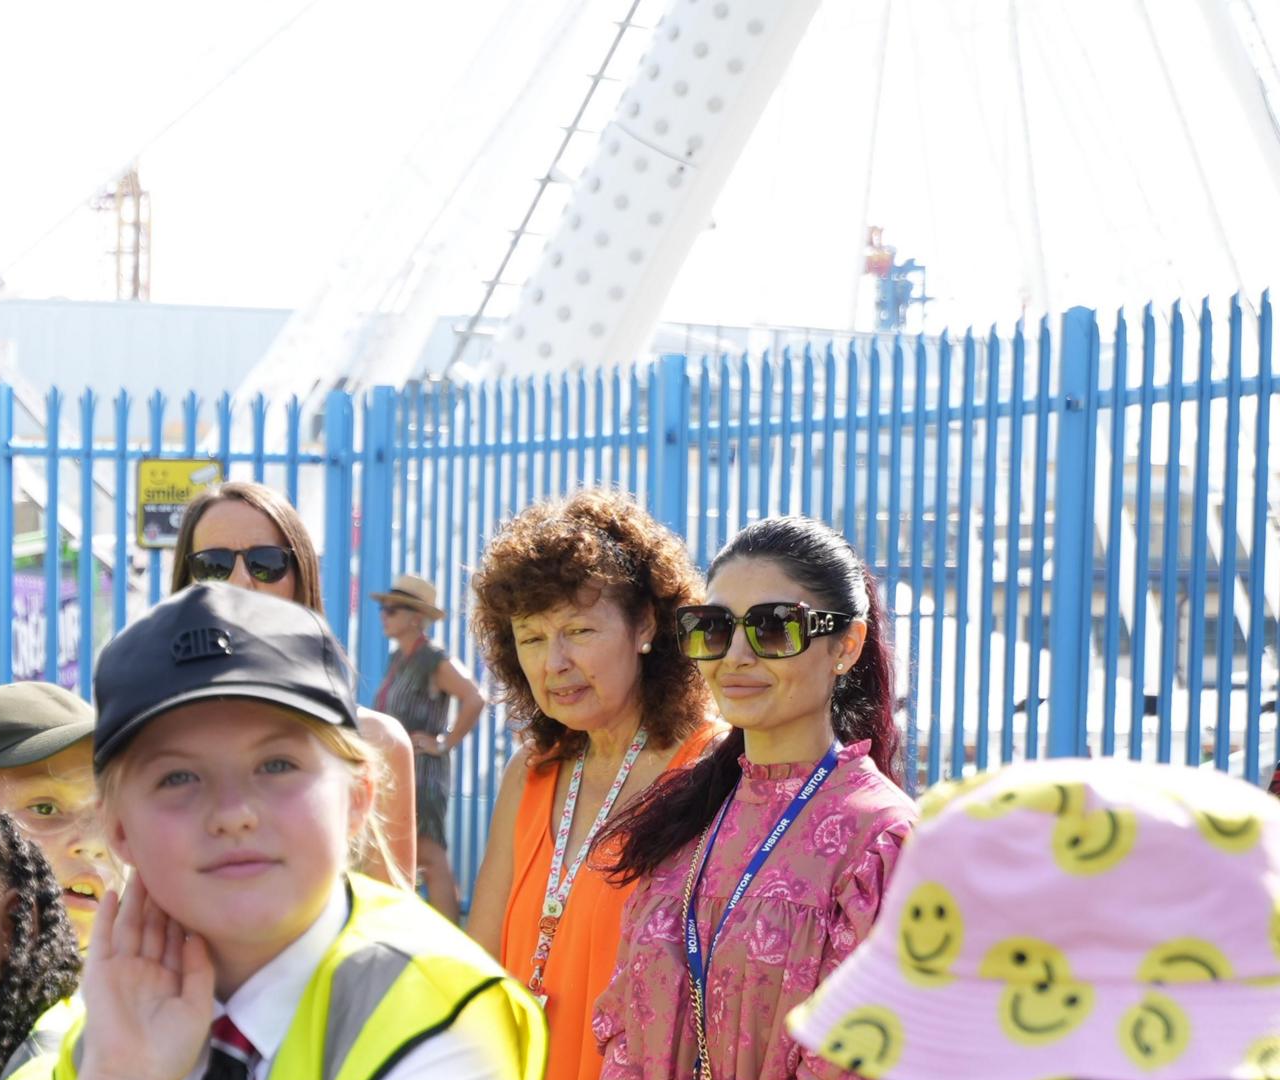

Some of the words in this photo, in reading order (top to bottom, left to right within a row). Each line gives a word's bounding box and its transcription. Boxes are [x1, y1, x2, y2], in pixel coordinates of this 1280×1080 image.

[798, 767, 828, 800] VISITOR
[761, 818, 790, 852] VISITOR
[728, 872, 752, 910] VISITOR
[688, 919, 698, 954] VISITOR
